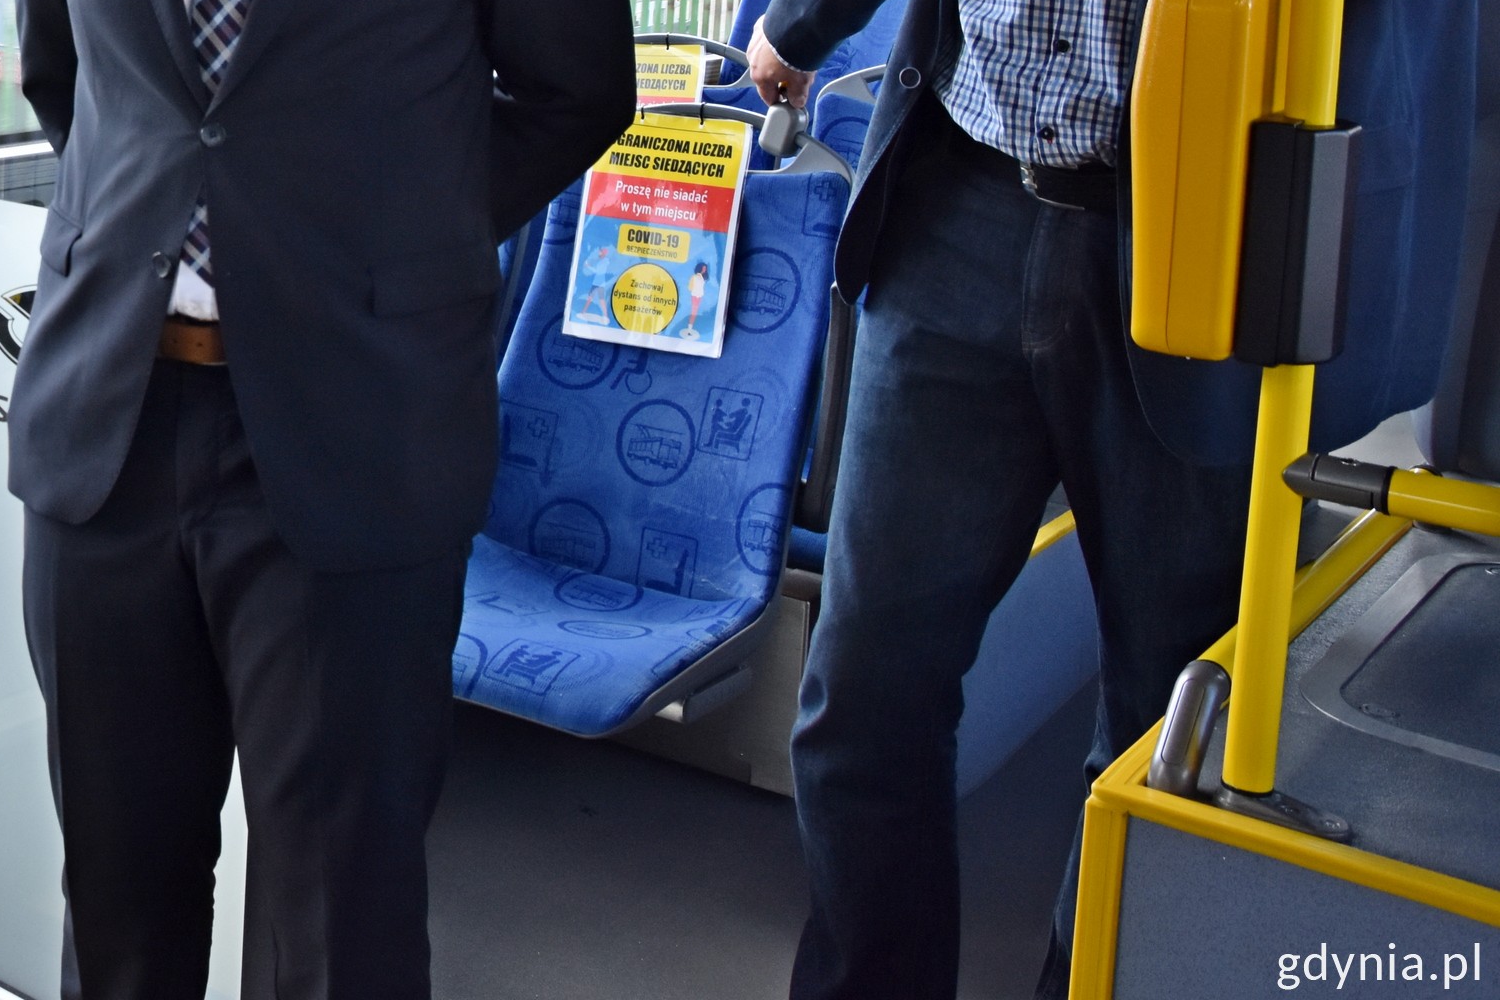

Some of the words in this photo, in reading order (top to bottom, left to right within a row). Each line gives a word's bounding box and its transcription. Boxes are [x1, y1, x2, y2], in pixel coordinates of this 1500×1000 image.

[636, 62, 659, 75] ZONA
[660, 63, 691, 75] LICZBA
[636, 78, 686, 92] IEDZĄCYCH
[692, 141, 733, 159] LICZBA
[609, 151, 651, 169] MIEJSC
[652, 157, 725, 178] SIEDZĄCYCH
[615, 180, 651, 199] Proszę
[653, 186, 670, 199] nie
[672, 188, 708, 204] siadać
[620, 202, 630, 212] w
[632, 202, 651, 217] tym
[654, 205, 697, 221] miejscu
[627, 229, 680, 248] COVID-19
[626, 245, 678, 259] BEZPIECZEŃSTWO
[630, 279, 664, 293] Zachowaj
[613, 288, 641, 301] dystans
[642, 292, 652, 302] od
[653, 294, 677, 307] innych
[623, 302, 662, 316] pasażerów
